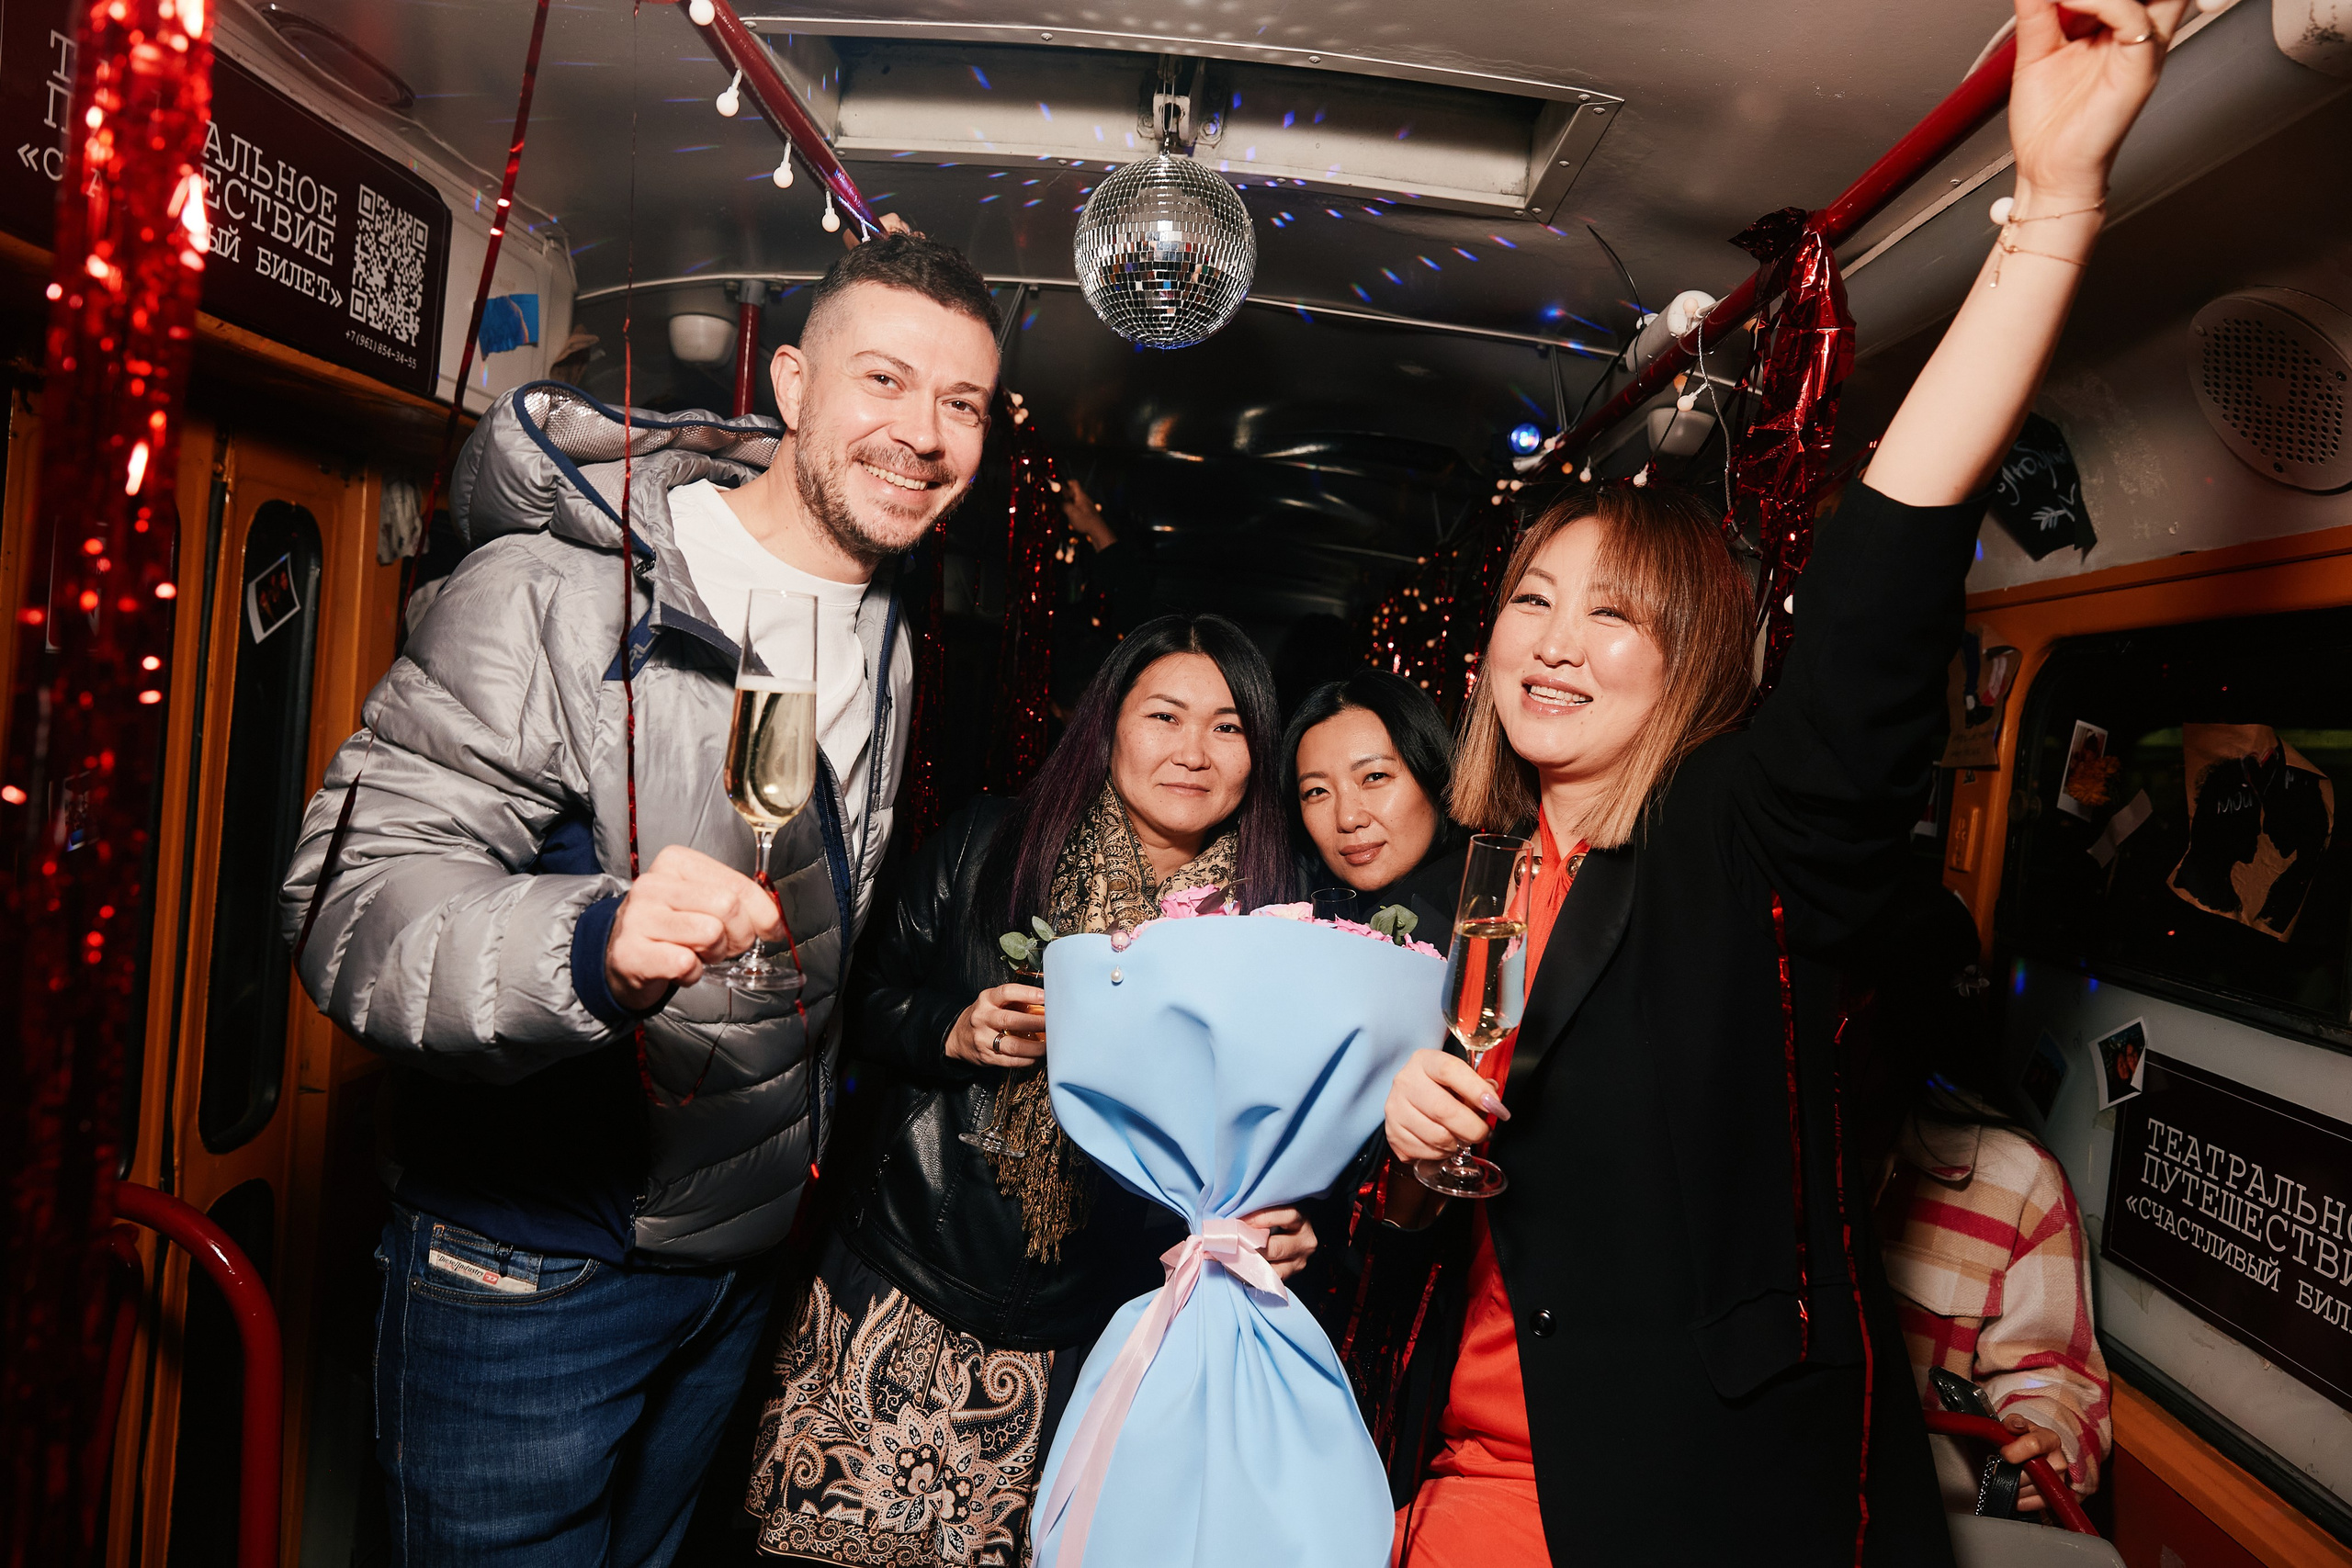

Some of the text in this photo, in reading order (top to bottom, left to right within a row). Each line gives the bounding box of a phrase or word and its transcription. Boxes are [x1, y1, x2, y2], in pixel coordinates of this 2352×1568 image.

[254, 245, 344, 308] БИЛЕТ»
[345, 329, 417, 370] +7(961)854-34-55
[2147, 1117, 2352, 1242] ТЕАТРАЛЬН
[2125, 1195, 2352, 1335] «СЧАСТЛИВЫЙ БИЛ
